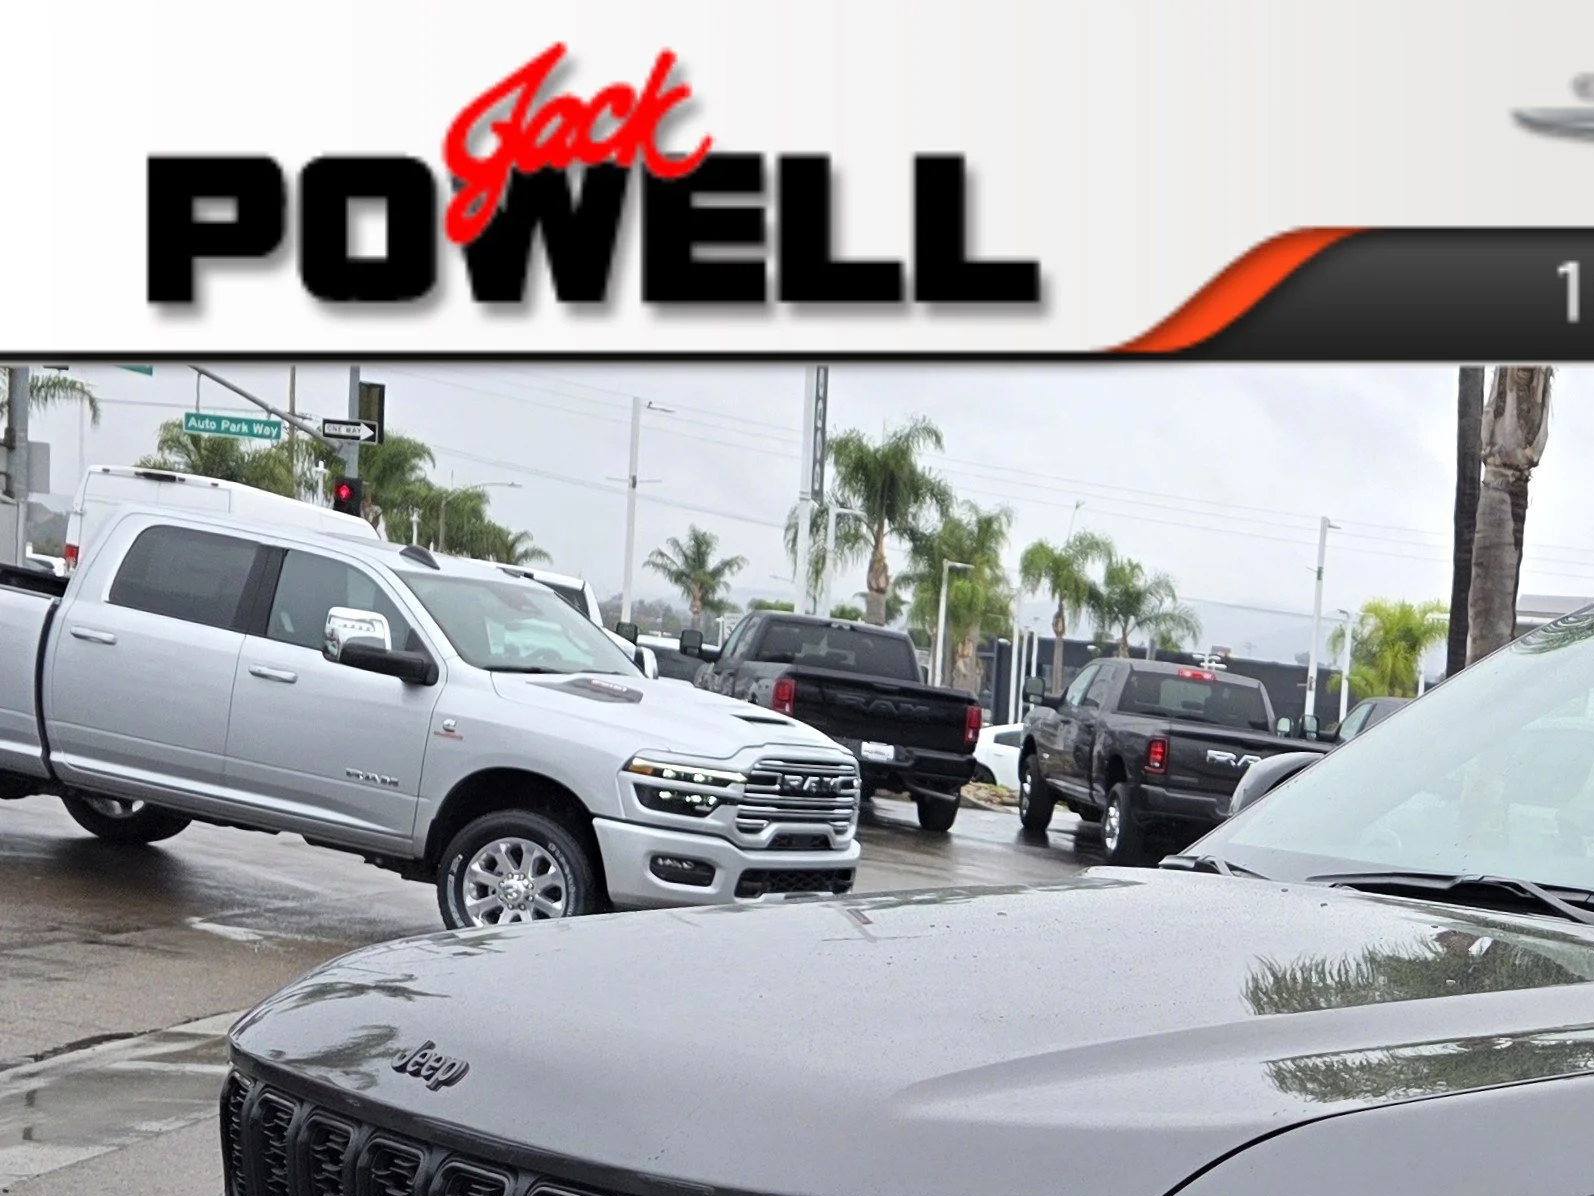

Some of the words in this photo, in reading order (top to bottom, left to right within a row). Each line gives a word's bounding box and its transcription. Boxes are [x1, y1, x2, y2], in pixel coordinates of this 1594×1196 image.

[187, 416, 217, 430] Auto
[221, 419, 249, 433] Park
[252, 423, 279, 438] Way
[326, 424, 342, 434] ONE
[1205, 749, 1262, 768] RA
[782, 774, 842, 796] RAM
[391, 1040, 470, 1092] Jeep
